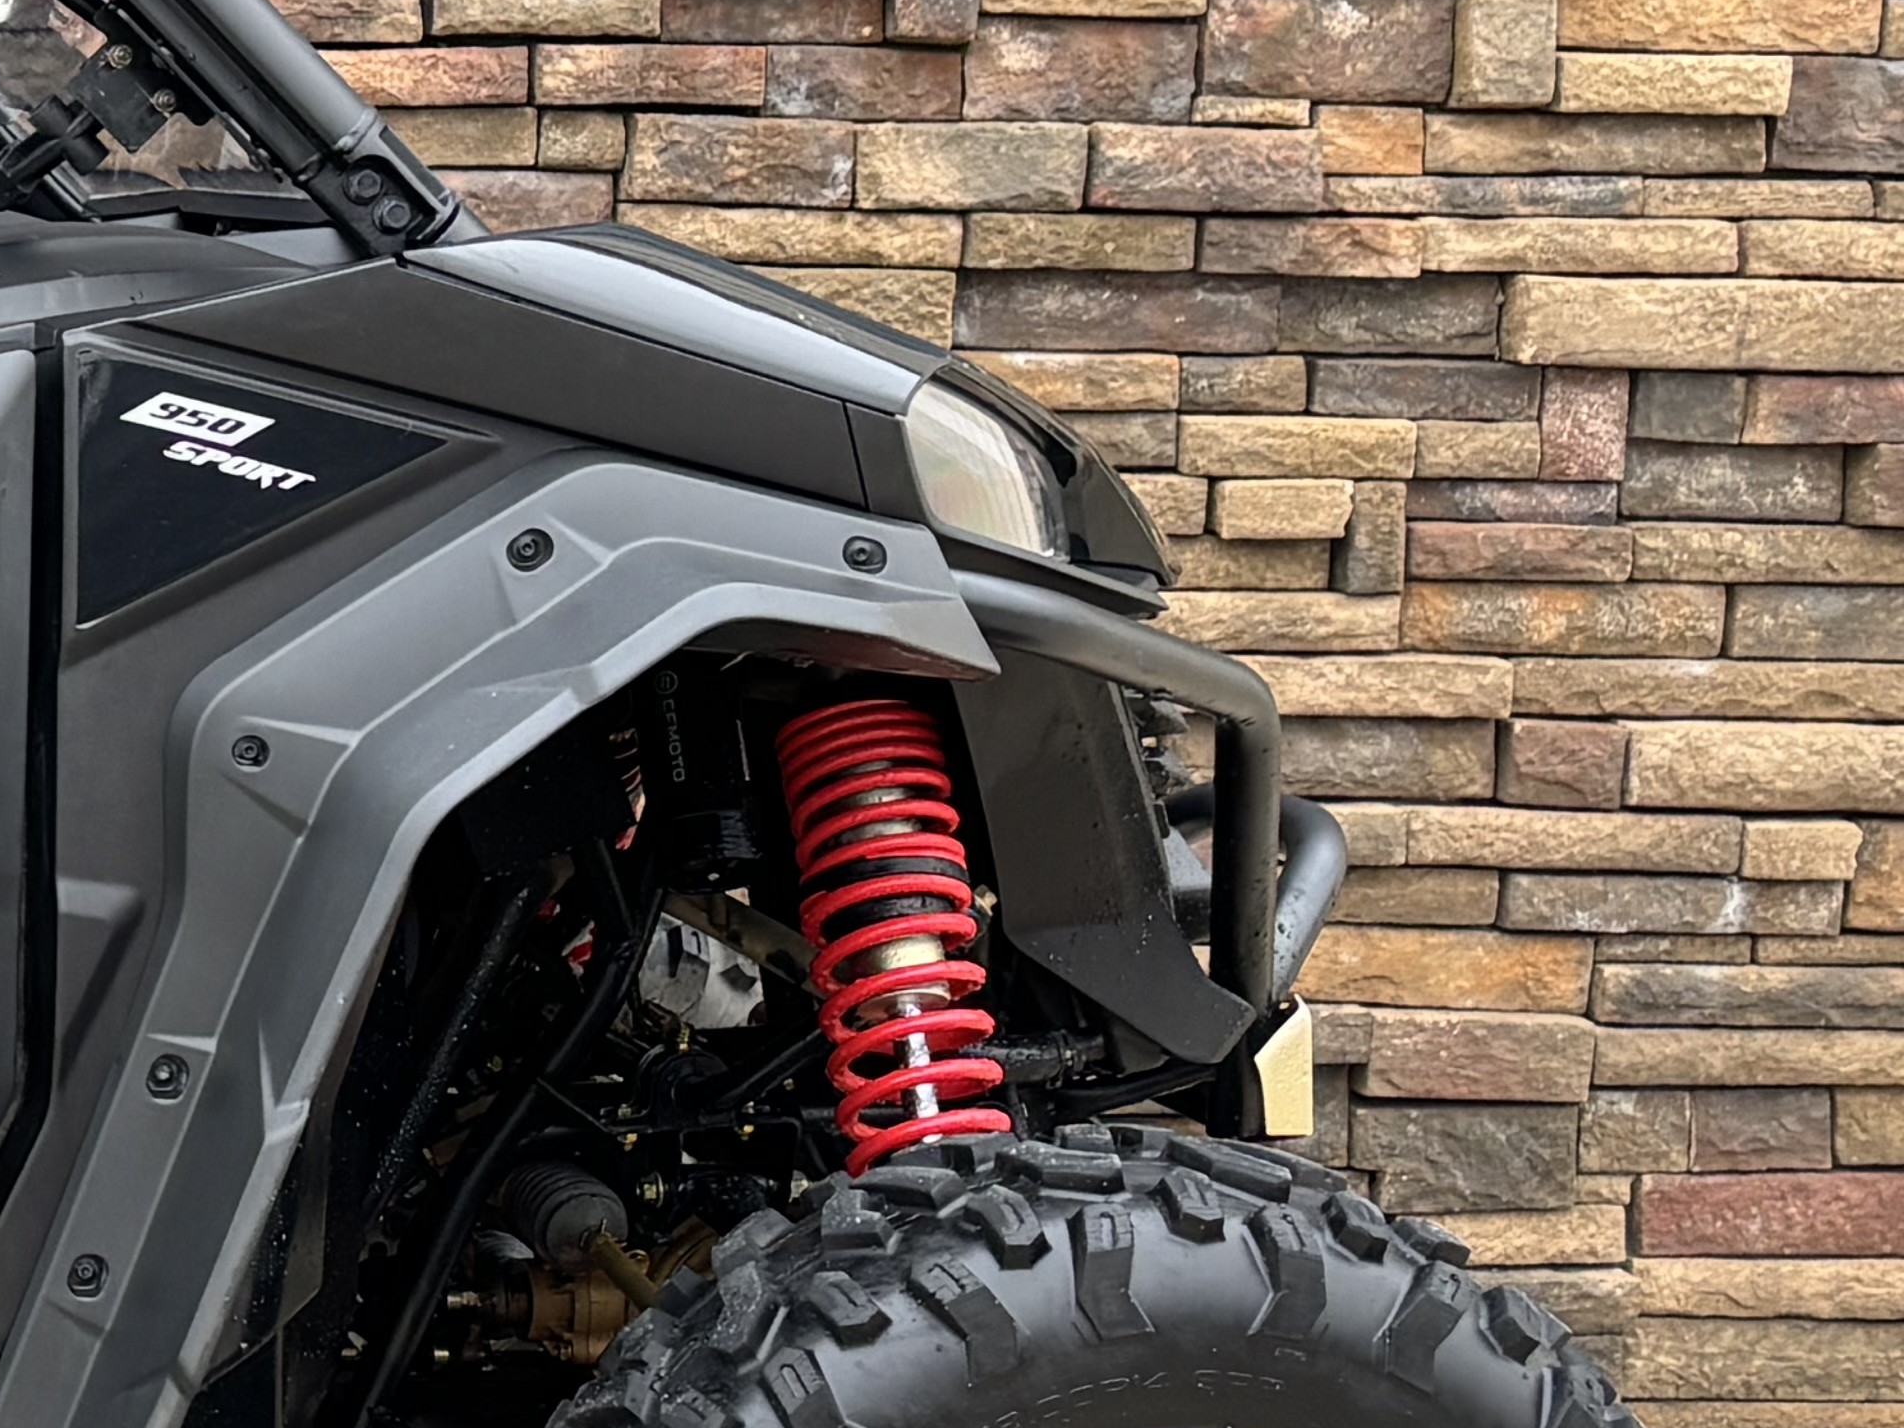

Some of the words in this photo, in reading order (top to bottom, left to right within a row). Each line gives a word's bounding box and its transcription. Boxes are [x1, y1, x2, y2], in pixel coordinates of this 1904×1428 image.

[146, 400, 248, 436] 950
[161, 439, 317, 491] SPORT
[662, 698, 686, 783] CFMOTO
